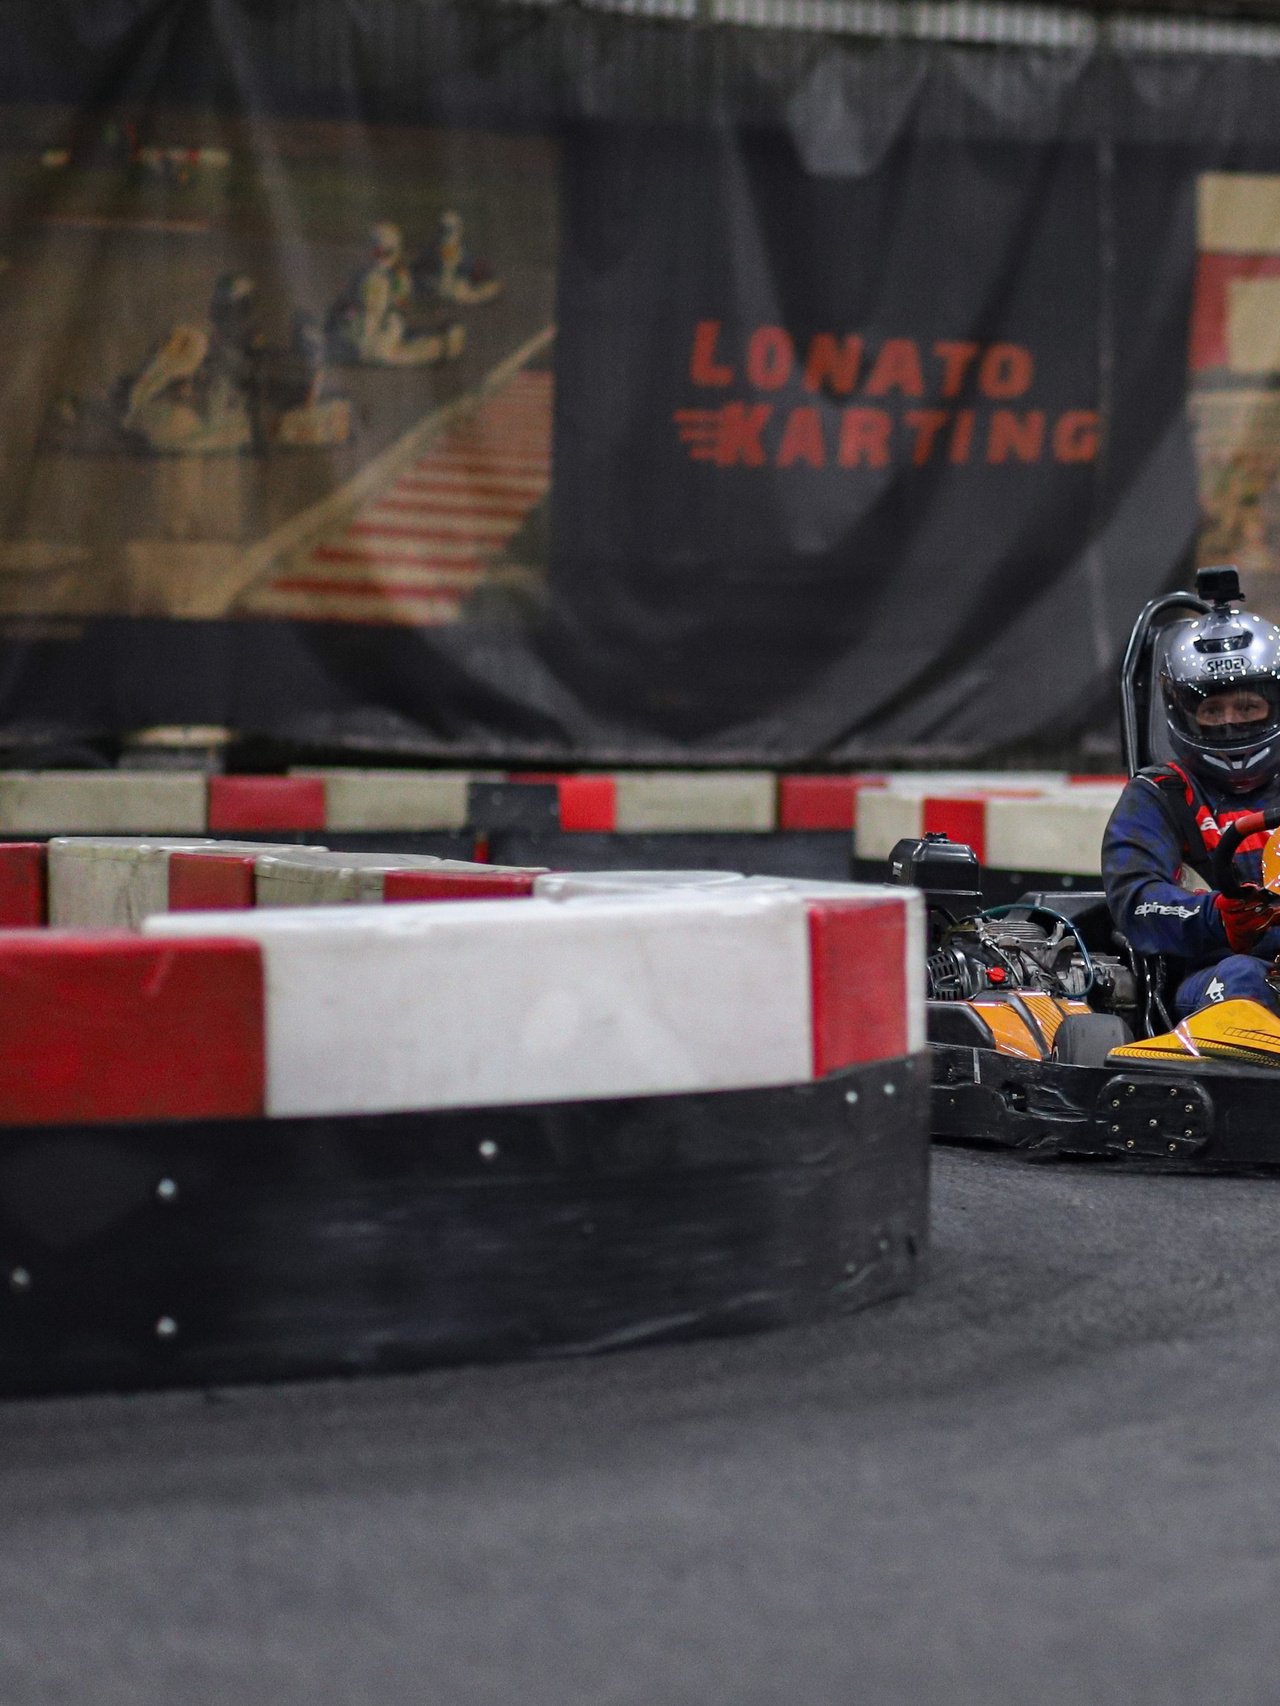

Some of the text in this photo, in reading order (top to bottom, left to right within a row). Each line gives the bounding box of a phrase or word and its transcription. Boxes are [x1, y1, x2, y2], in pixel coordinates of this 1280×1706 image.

[689, 319, 1033, 399] LONATO
[708, 400, 1100, 469] KARTING
[1207, 658, 1245, 672] SHOEI
[1134, 901, 1201, 919] alpinestas
